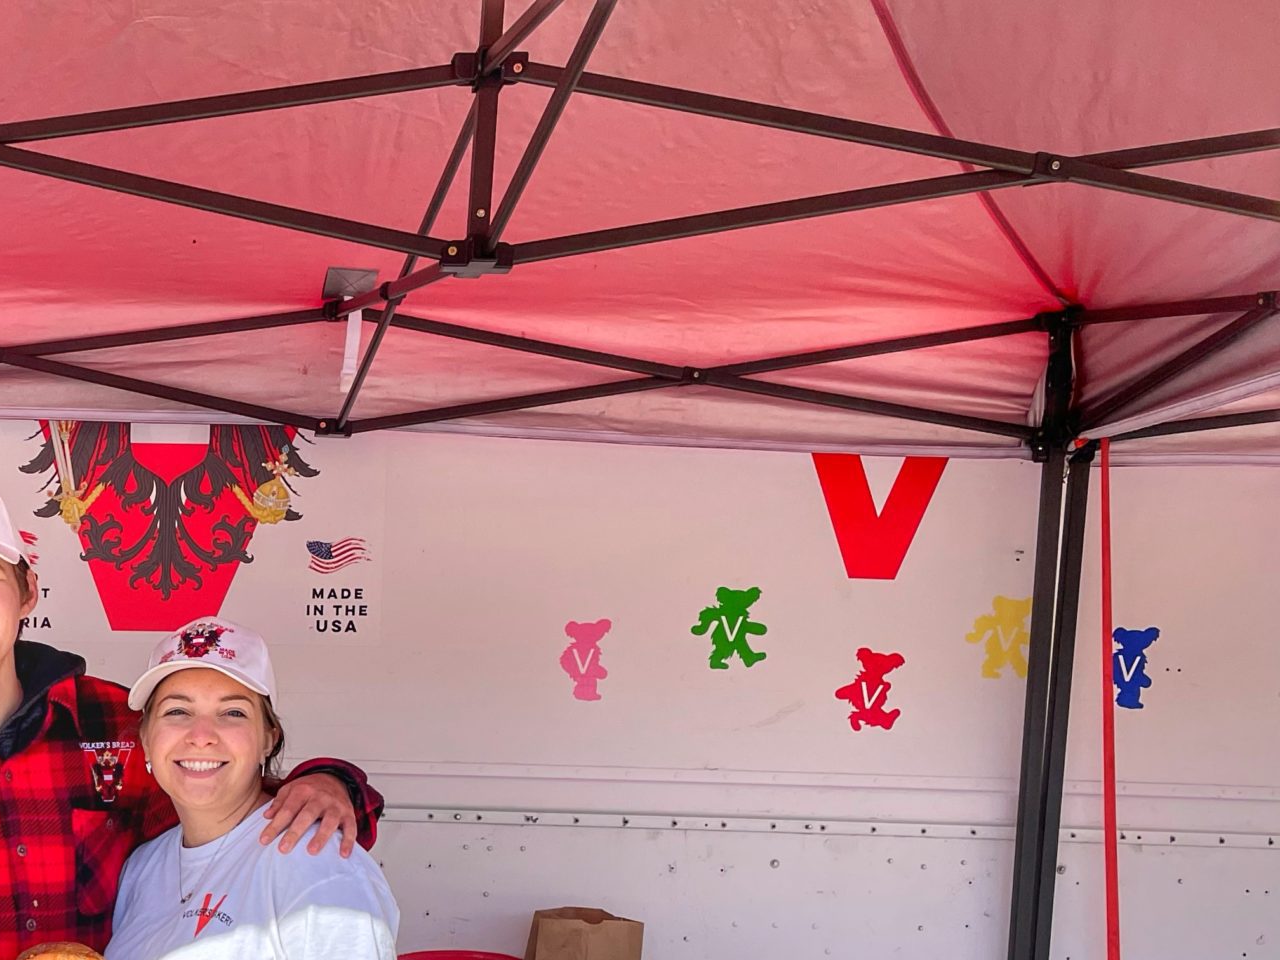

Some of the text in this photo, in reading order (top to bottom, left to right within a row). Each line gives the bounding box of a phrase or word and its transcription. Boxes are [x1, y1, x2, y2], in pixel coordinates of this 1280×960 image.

[312, 588, 363, 600] MADE
[306, 605, 368, 617] IN THE
[316, 619, 357, 633] USA
[79, 741, 135, 749] VOLKER'S BREAD
